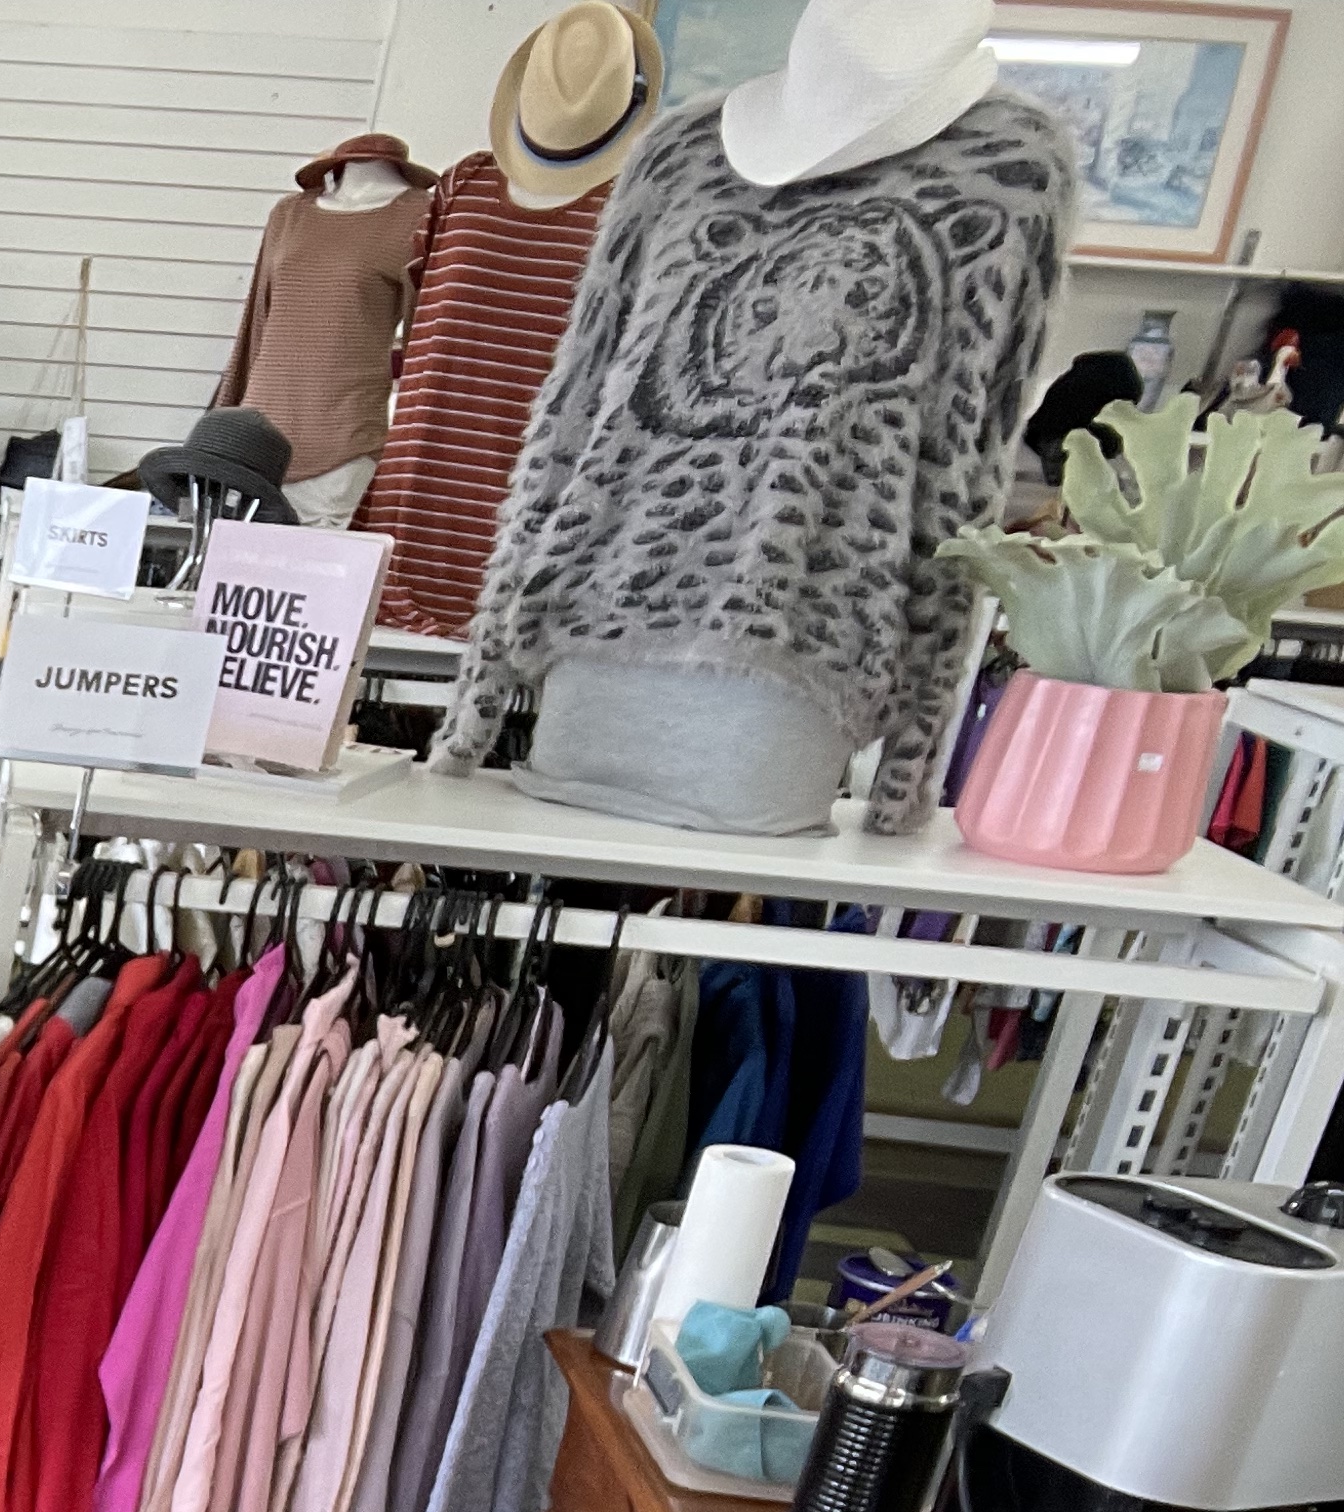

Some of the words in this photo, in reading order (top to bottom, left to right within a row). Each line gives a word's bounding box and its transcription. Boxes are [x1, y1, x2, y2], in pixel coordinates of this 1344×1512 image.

[48, 525, 108, 547] SKIRTS
[211, 581, 309, 629] MOVE.
[35, 665, 179, 698] JUMPERS
[218, 655, 321, 706] ELIEVE.
